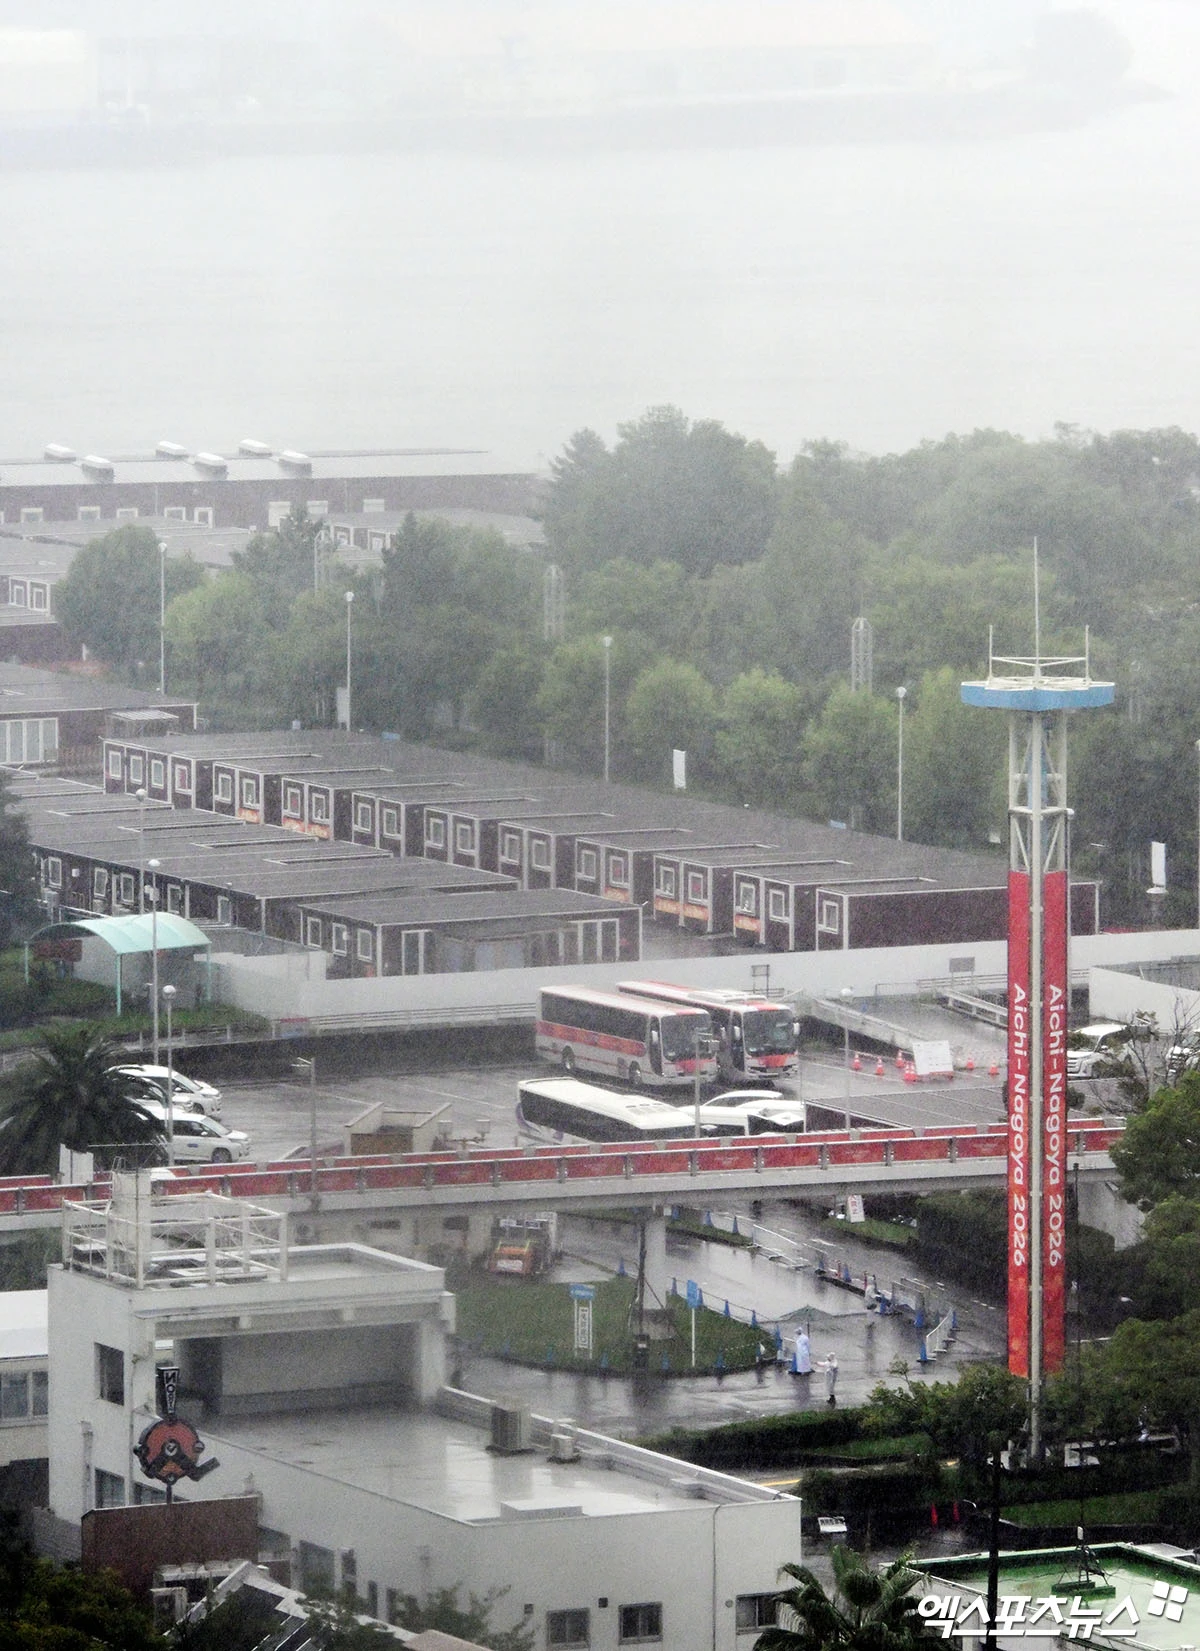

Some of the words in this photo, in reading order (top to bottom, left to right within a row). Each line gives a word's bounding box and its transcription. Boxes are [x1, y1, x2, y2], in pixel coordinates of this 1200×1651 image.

[1011, 983, 1027, 1185] Aichi-Nagoya
[1046, 983, 1064, 1185] Aichi-Nagoya
[1013, 1194, 1027, 1267] 2026
[1049, 1194, 1063, 1267] 2026
